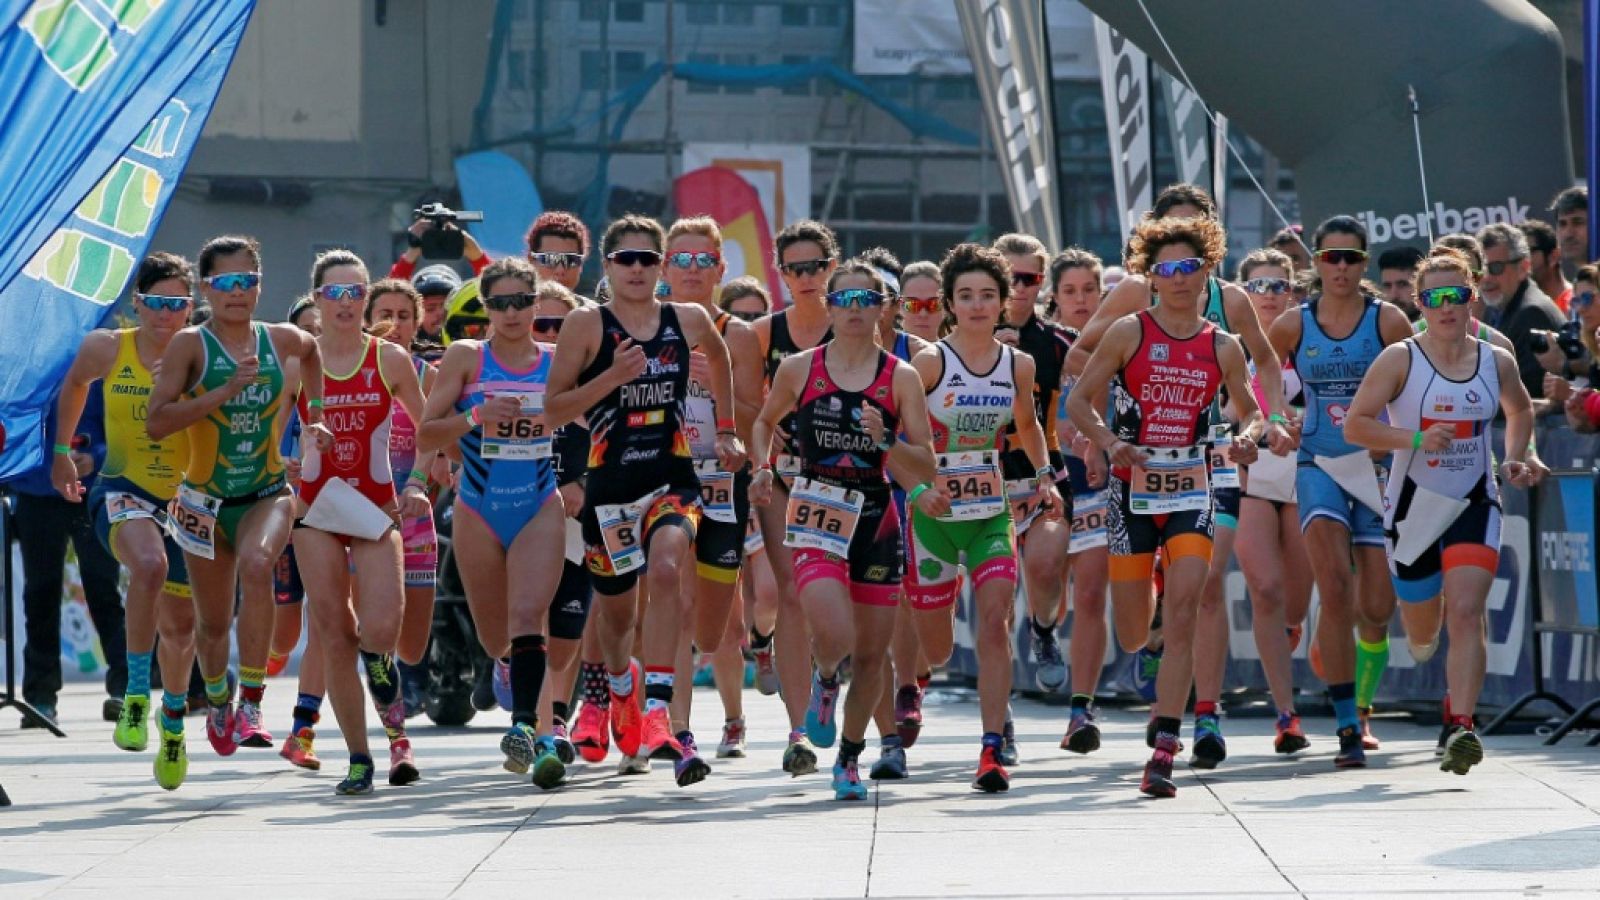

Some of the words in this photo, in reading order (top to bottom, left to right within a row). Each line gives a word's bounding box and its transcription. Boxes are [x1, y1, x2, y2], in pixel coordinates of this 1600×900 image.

[620, 381, 675, 408] PINTANEL
[956, 394, 1012, 408] SALTOKI
[1141, 383, 1207, 407] BONILLA
[230, 411, 260, 435] BREA
[497, 419, 545, 437] 96a
[946, 477, 993, 498] 94a
[1145, 473, 1195, 492] 95a
[794, 504, 843, 535] 91a
[1070, 513, 1108, 533] 20
